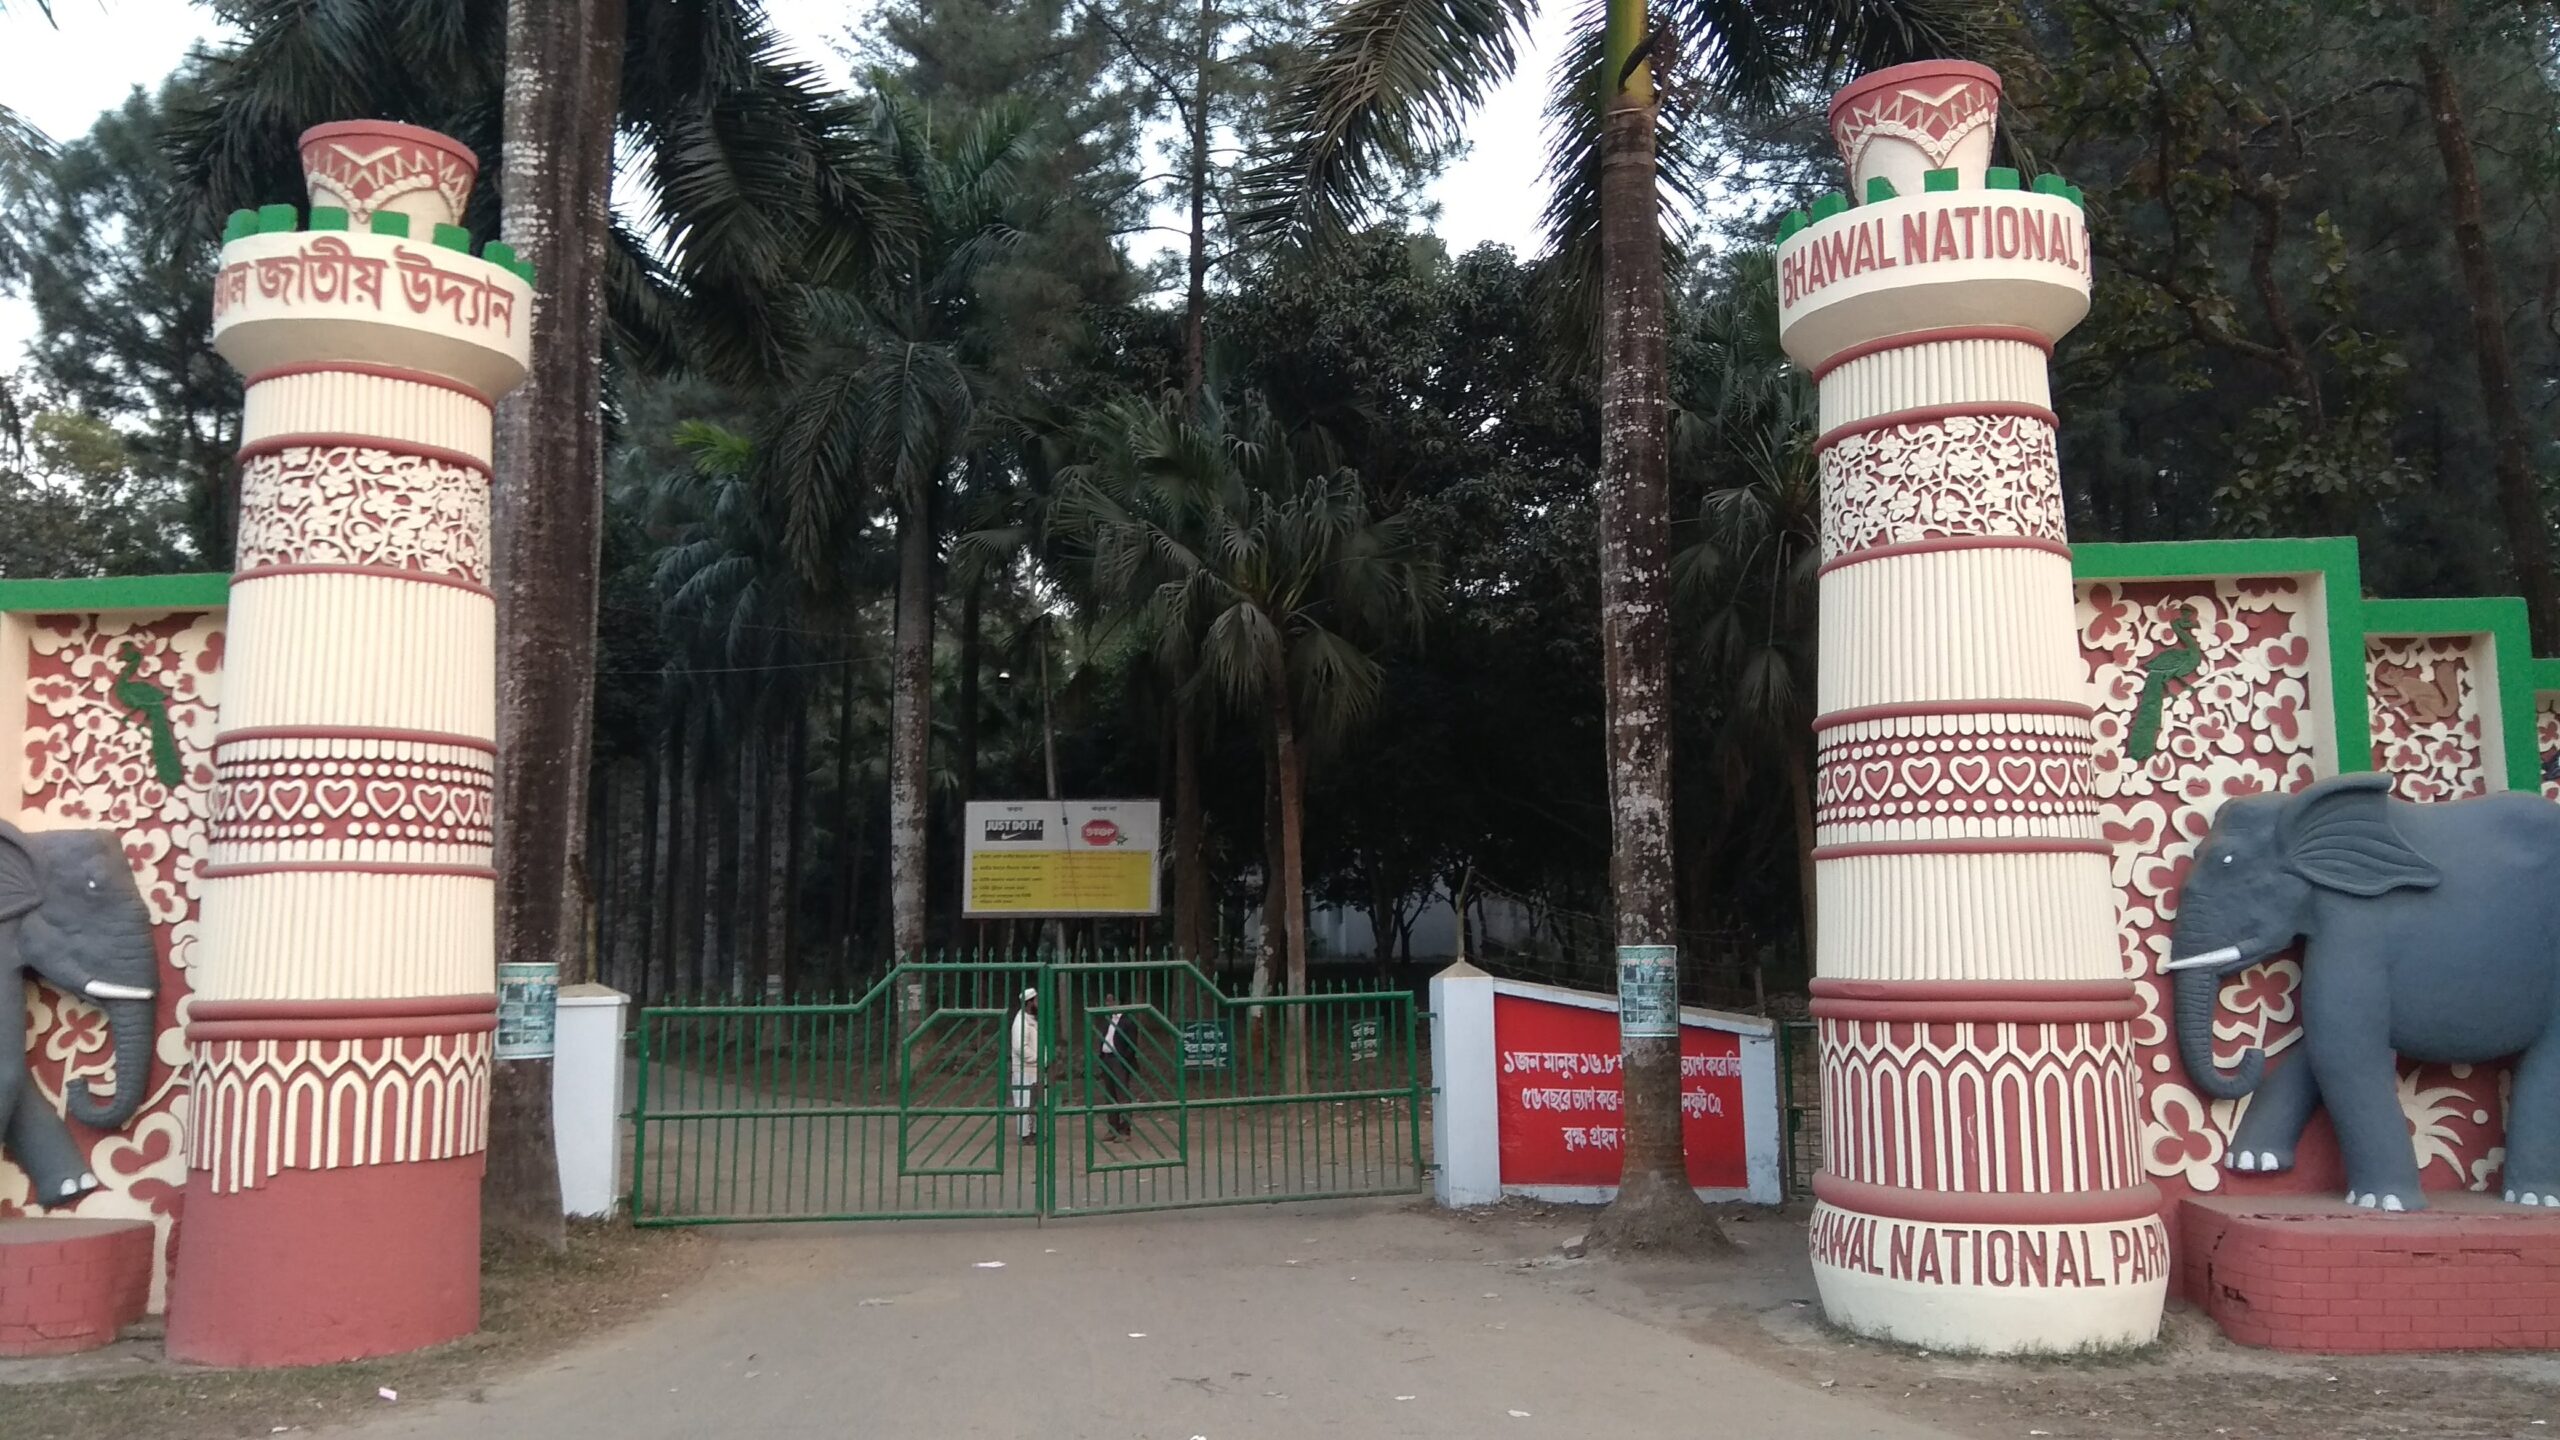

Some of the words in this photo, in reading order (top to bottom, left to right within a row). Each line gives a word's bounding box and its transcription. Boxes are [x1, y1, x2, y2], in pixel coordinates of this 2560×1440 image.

[1782, 218, 1897, 310] BHAWAL
[1902, 206, 2080, 272] NATIONAL
[255, 236, 388, 310] জাতীয়
[394, 245, 514, 338] উদ্যান
[986, 820, 1011, 831] JUST
[1012, 820, 1027, 831] DO
[1085, 828, 1115, 837] STOP
[1543, 1053, 1579, 1079] মানুষ
[1890, 1223, 2106, 1288] NATIONAL
[2109, 1222, 2168, 1285] PARK
